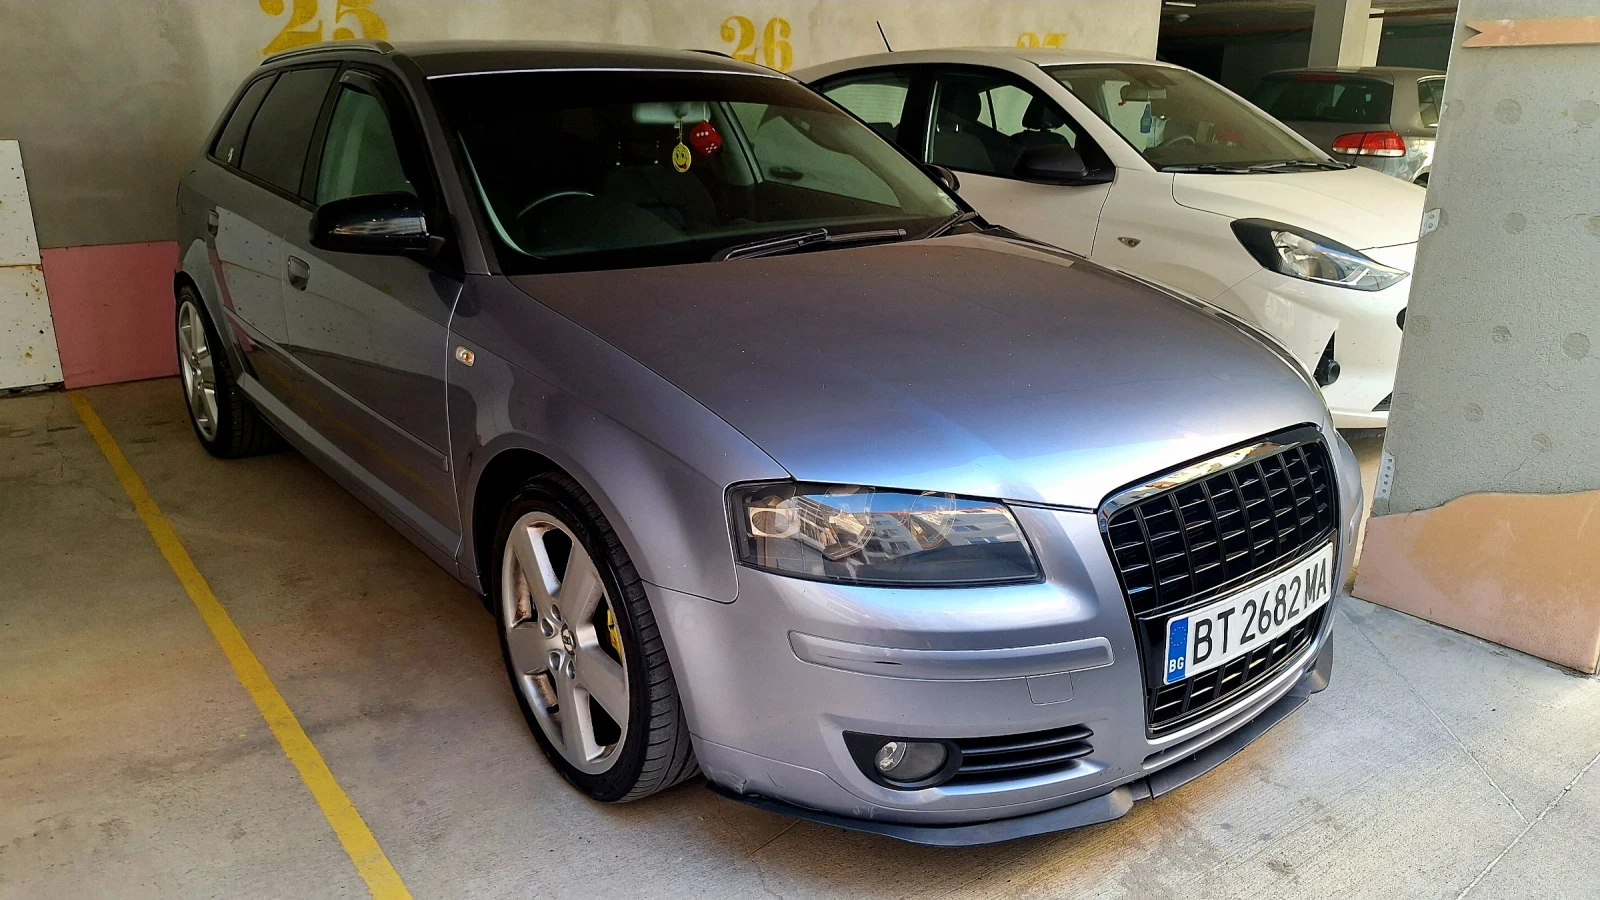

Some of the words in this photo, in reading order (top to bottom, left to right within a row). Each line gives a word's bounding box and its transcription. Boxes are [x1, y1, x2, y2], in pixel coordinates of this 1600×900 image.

[721, 15, 794, 73] 26
[1192, 606, 1236, 666] BT
[1240, 575, 1302, 646] 2682
[1304, 557, 1327, 610] MA
[1169, 656, 1185, 674] BG
